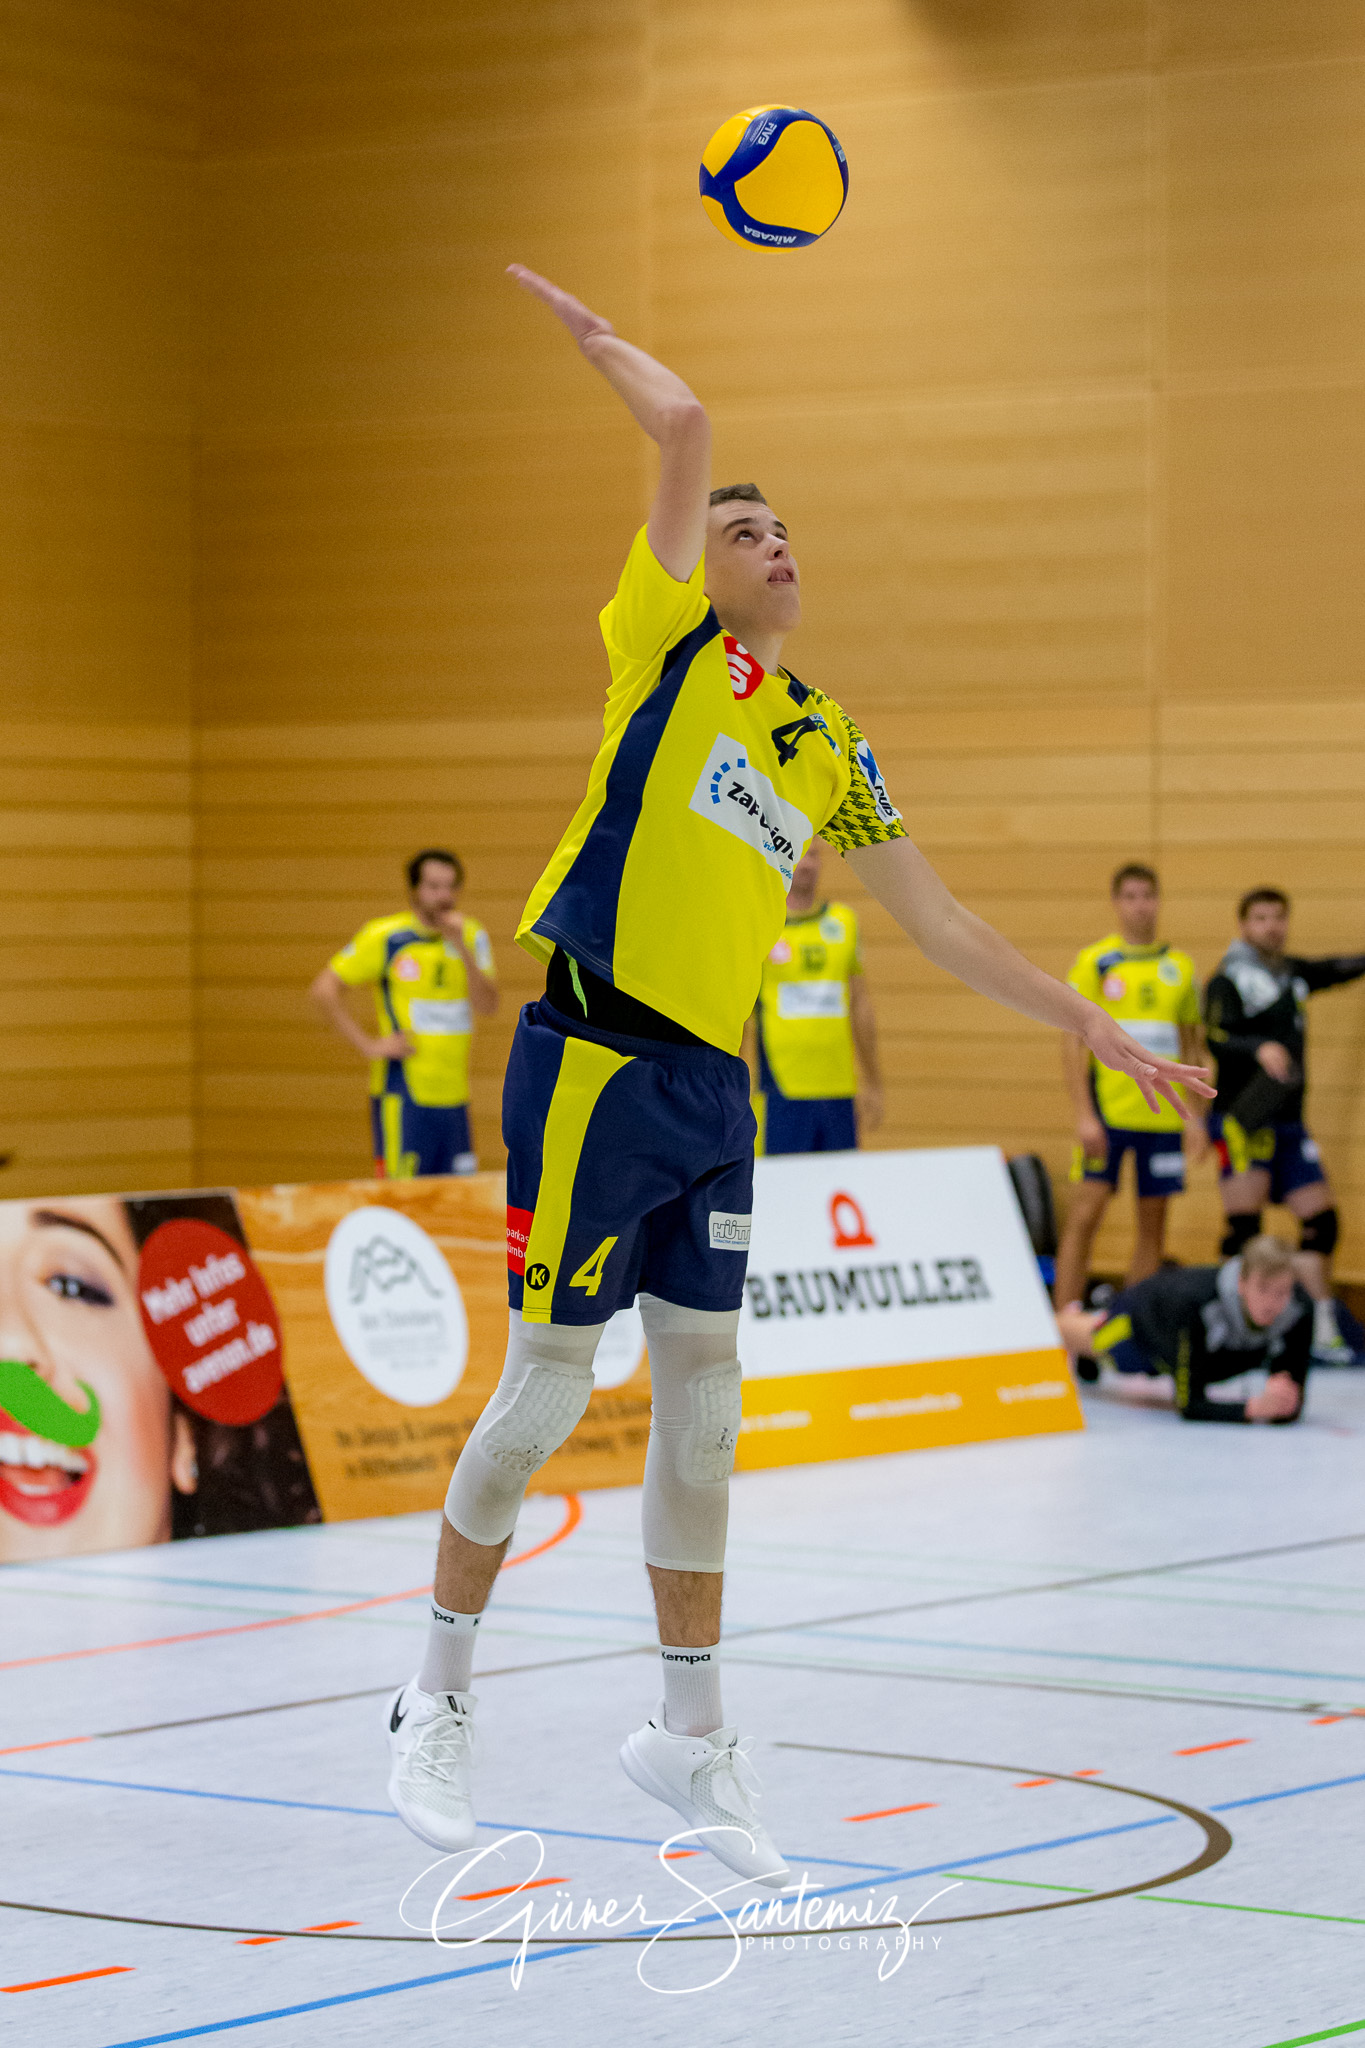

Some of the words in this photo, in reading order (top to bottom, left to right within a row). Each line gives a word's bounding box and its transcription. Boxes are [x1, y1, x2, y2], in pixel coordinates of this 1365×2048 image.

[771, 715, 819, 768] 4
[568, 1236, 619, 1296] 4
[182, 1297, 241, 1348] unter
